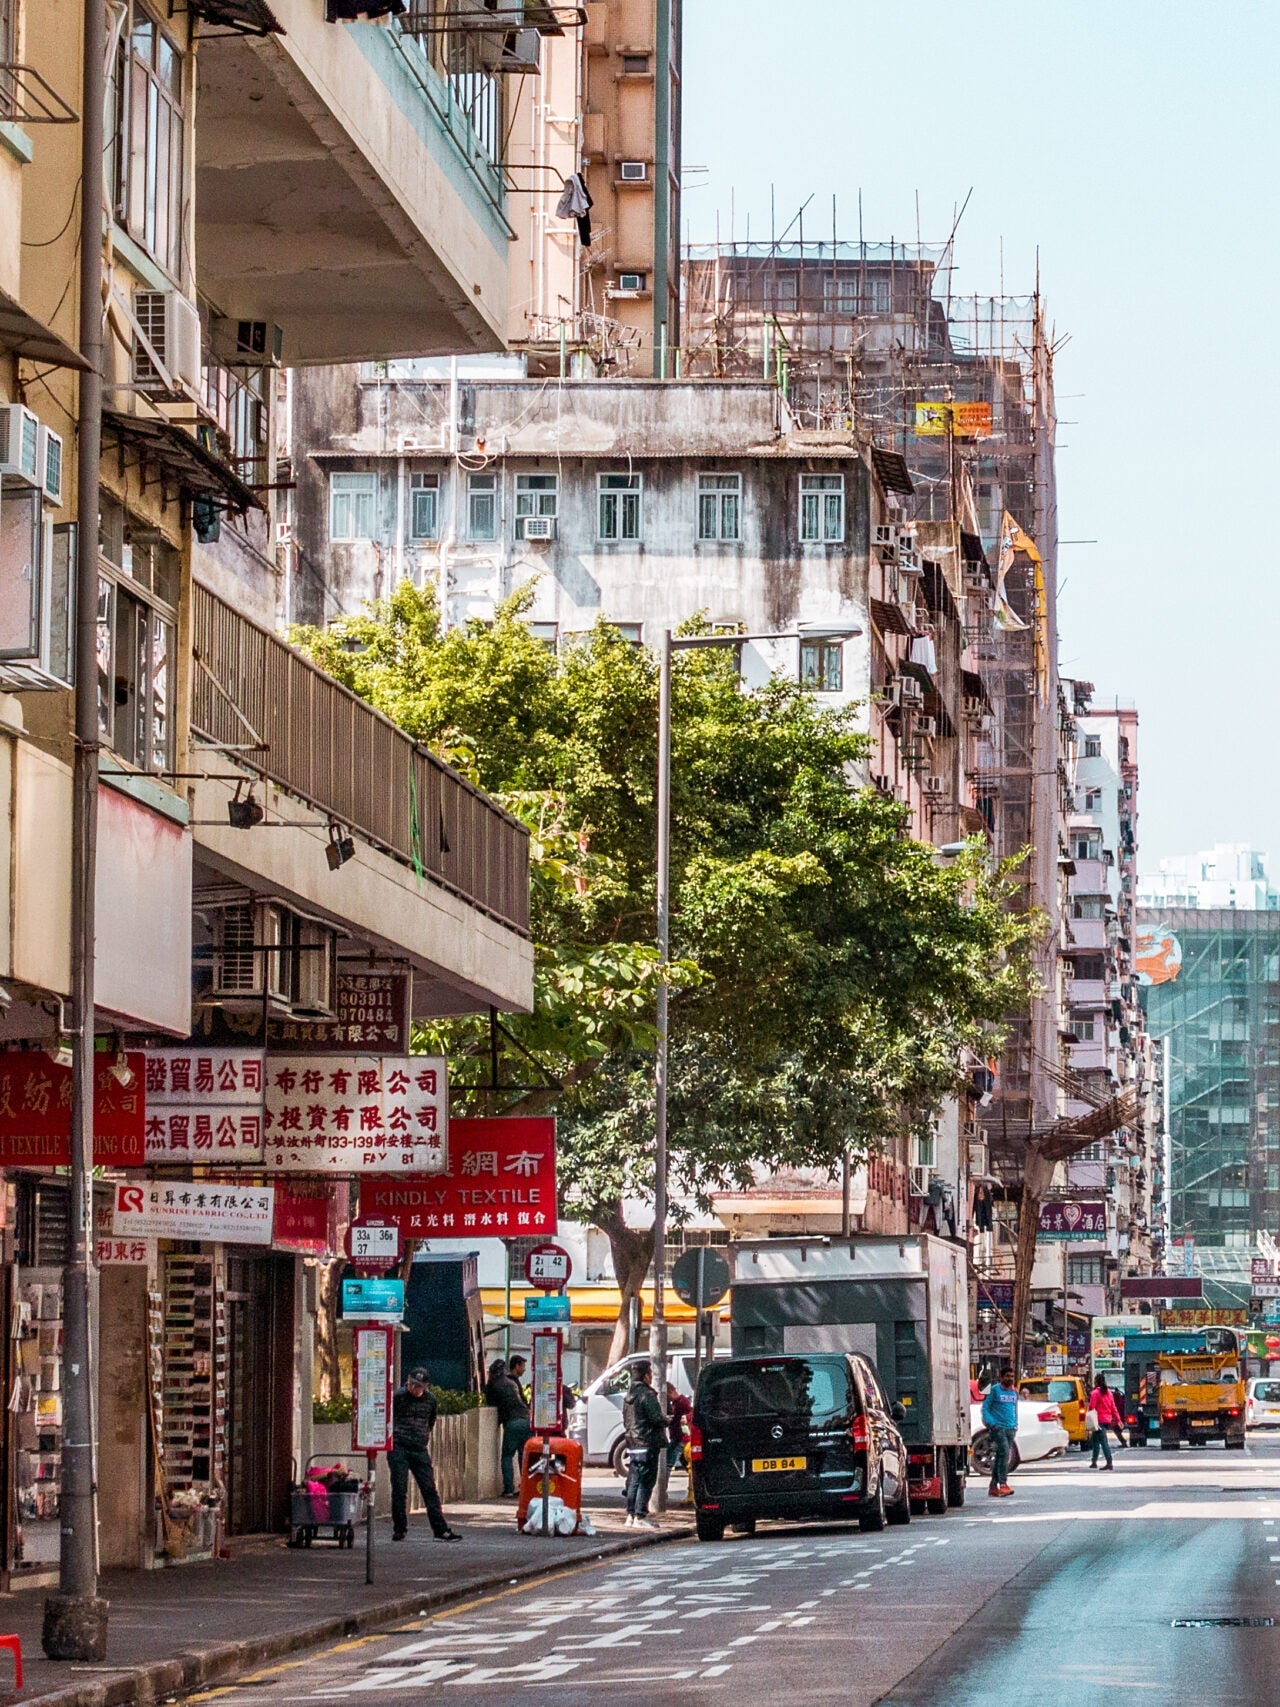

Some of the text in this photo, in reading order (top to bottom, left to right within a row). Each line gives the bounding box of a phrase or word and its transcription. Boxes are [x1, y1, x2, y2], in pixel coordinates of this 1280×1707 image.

[265, 1067, 437, 1096] 布行有限公司
[99, 1095, 138, 1115] 公司
[10, 1135, 60, 1155] TEXTILE
[122, 1135, 140, 1155] CO.
[375, 1188, 541, 1206] KINDLY TEXTILE
[150, 1206, 188, 1215] SUNRISE
[192, 1208, 226, 1218] FABRIC
[1081, 1213, 1105, 1230] 酒店
[356, 1229, 393, 1241] 33A 36B
[98, 1240, 147, 1262] 利東行
[357, 1243, 368, 1255] 37
[552, 1256, 562, 1266] 42
[534, 1267, 544, 1277] 44
[762, 1460, 777, 1469] DB
[604, 1560, 827, 1577] 巴士
[512, 1592, 756, 1613] BUS
[422, 1605, 775, 1632] STOP
[376, 1624, 684, 1660] 巴士
[311, 1655, 597, 1695] 站
